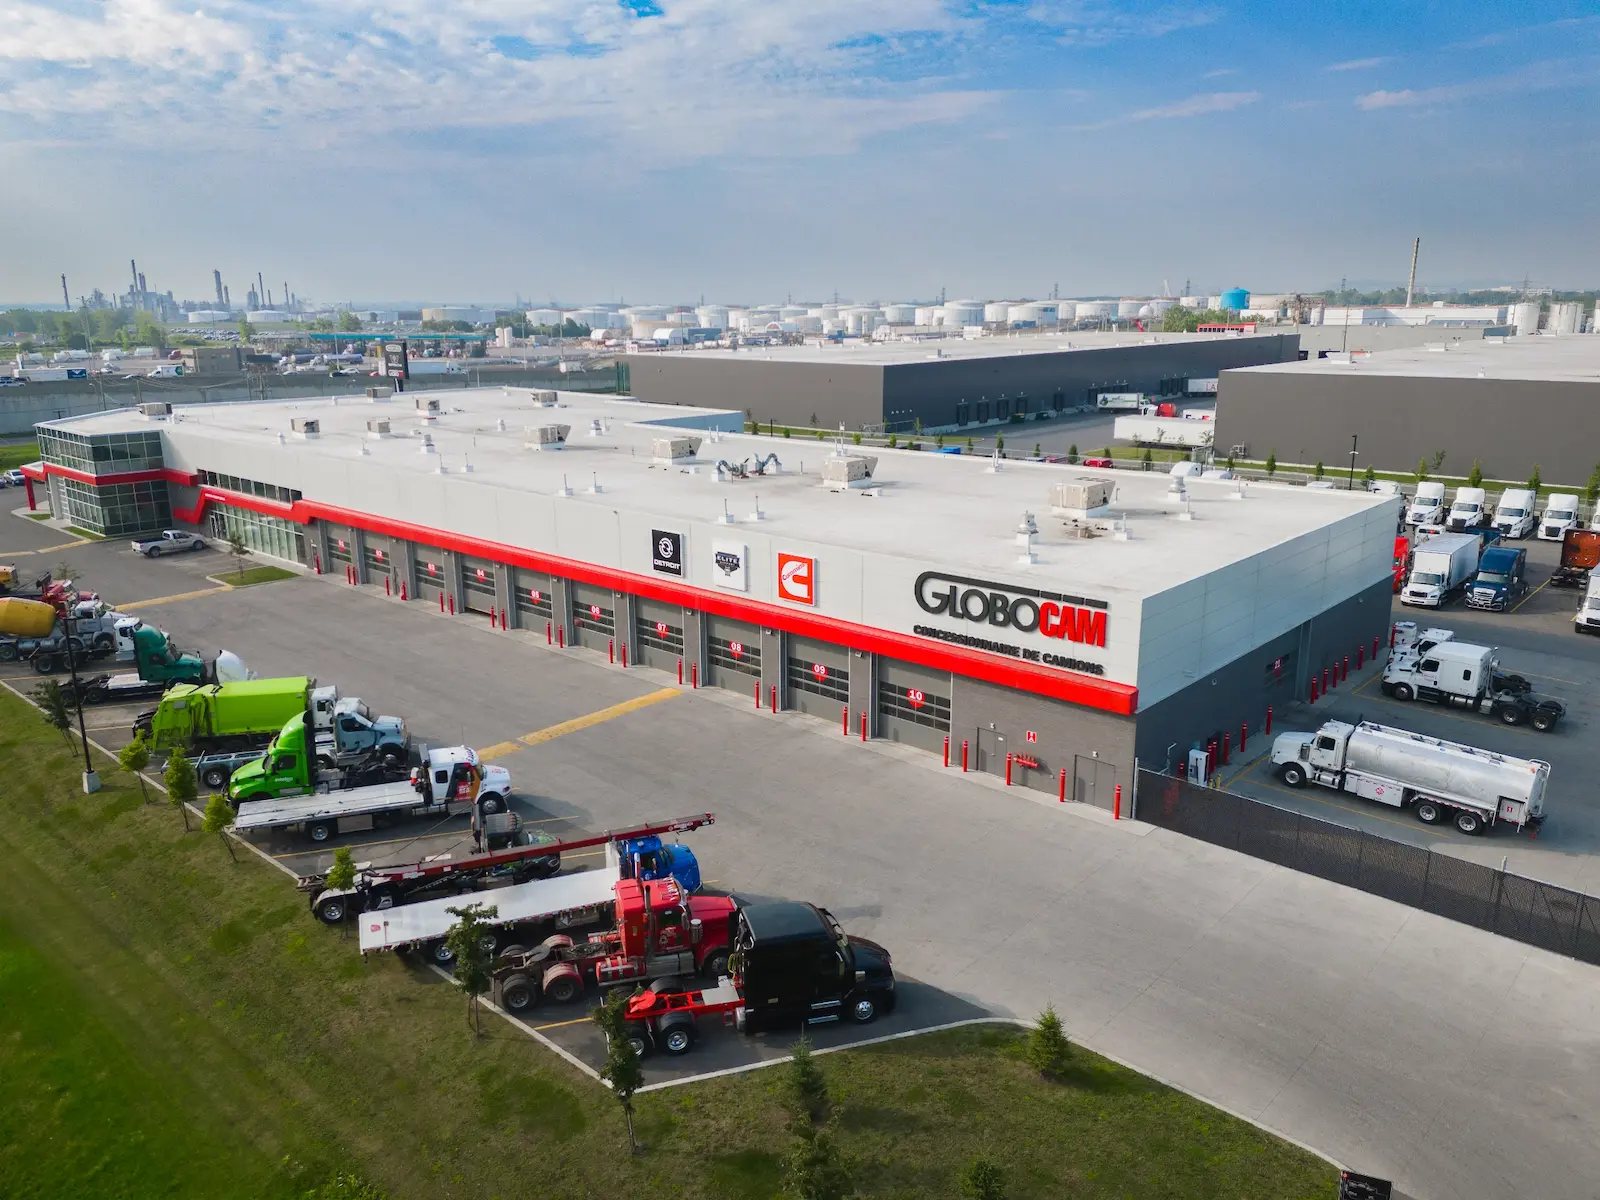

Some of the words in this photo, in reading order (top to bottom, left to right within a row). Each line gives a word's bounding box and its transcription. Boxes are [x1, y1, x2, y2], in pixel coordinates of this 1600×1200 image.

[653, 558, 681, 570] DETROIT
[716, 555, 739, 564] ELITE
[427, 563, 436, 571] 03
[782, 563, 806, 581] Cummins
[476, 569, 485, 577] 04
[531, 590, 540, 599] 05
[591, 605, 600, 615] 06
[914, 571, 1108, 648] GLOBOCAM
[657, 623, 667, 632] 07
[730, 641, 742, 652] 08
[913, 624, 1020, 657] CONCESSIONNAIRE
[1022, 647, 1041, 662] DE
[1042, 652, 1104, 676] CAMIONS
[813, 664, 826, 675] 09
[909, 689, 923, 701] 10
